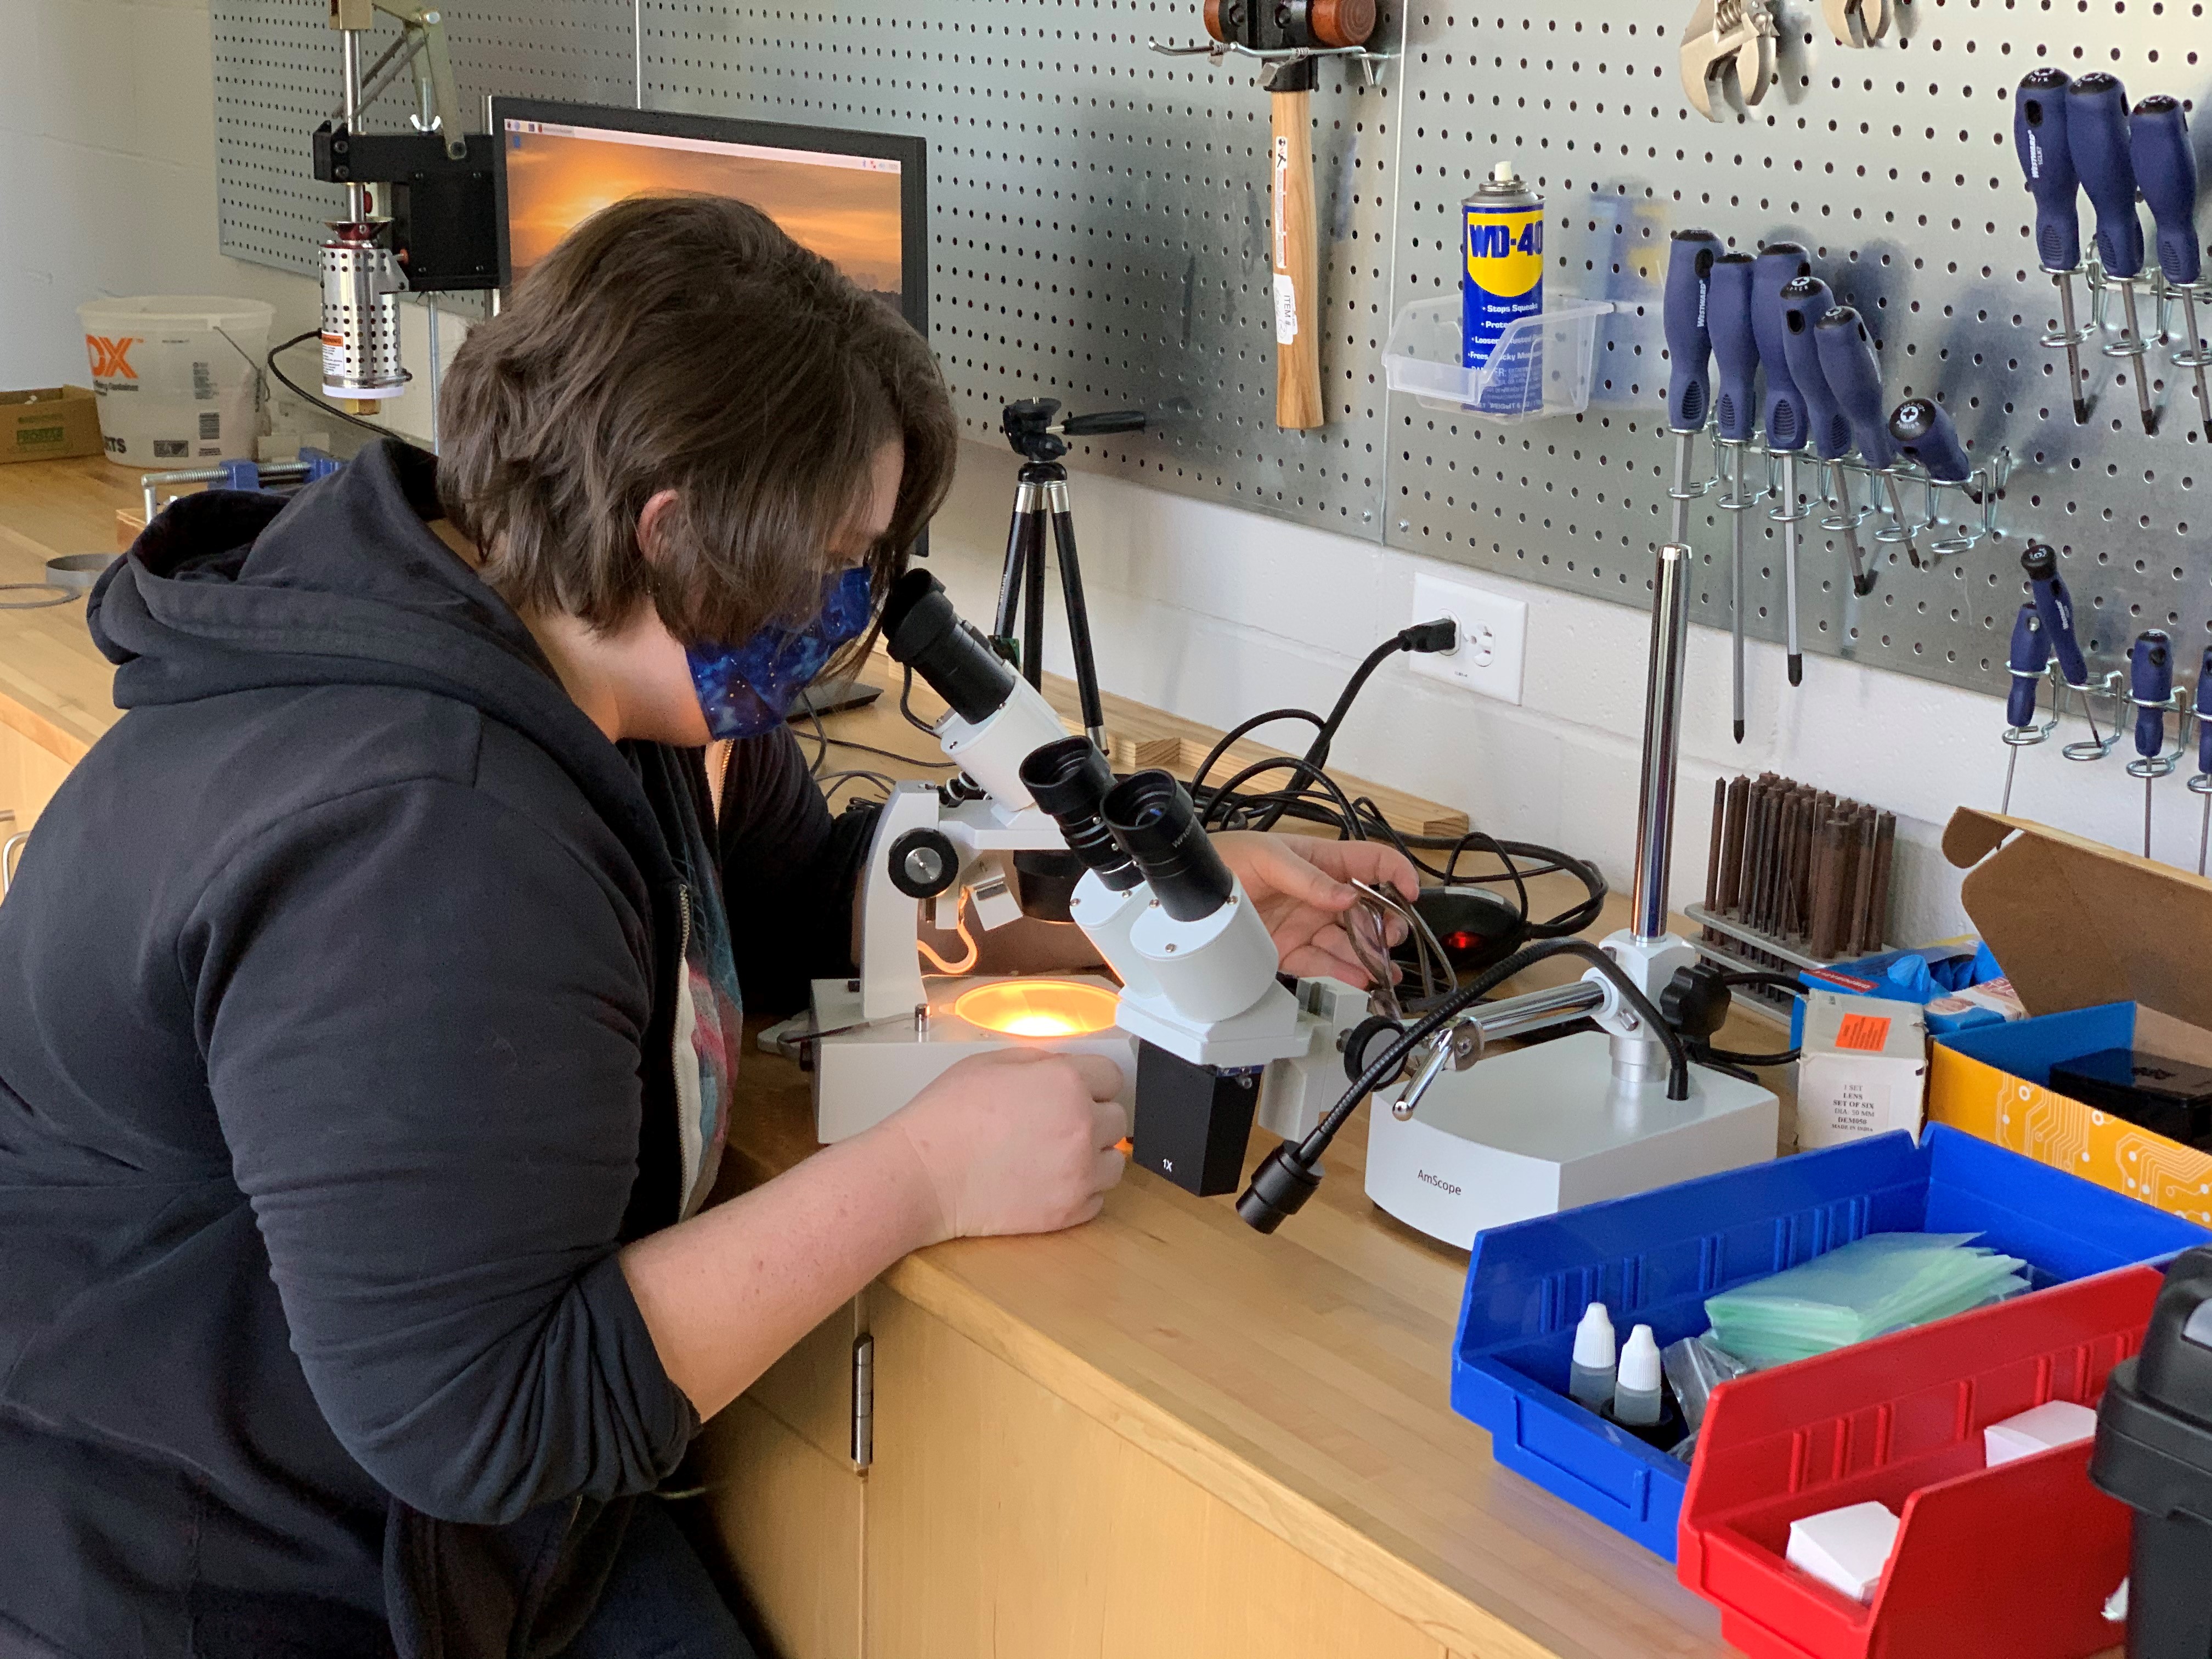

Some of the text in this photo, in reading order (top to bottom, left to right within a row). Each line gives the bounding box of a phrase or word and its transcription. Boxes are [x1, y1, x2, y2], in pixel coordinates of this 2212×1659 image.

[1469, 220, 1543, 258] WD-40
[1487, 302, 1538, 314] Stops Squeaks
[1470, 351, 1489, 360] Frees
[1163, 1158, 1173, 1173] 1X
[1417, 1169, 1462, 1195] AmScope
